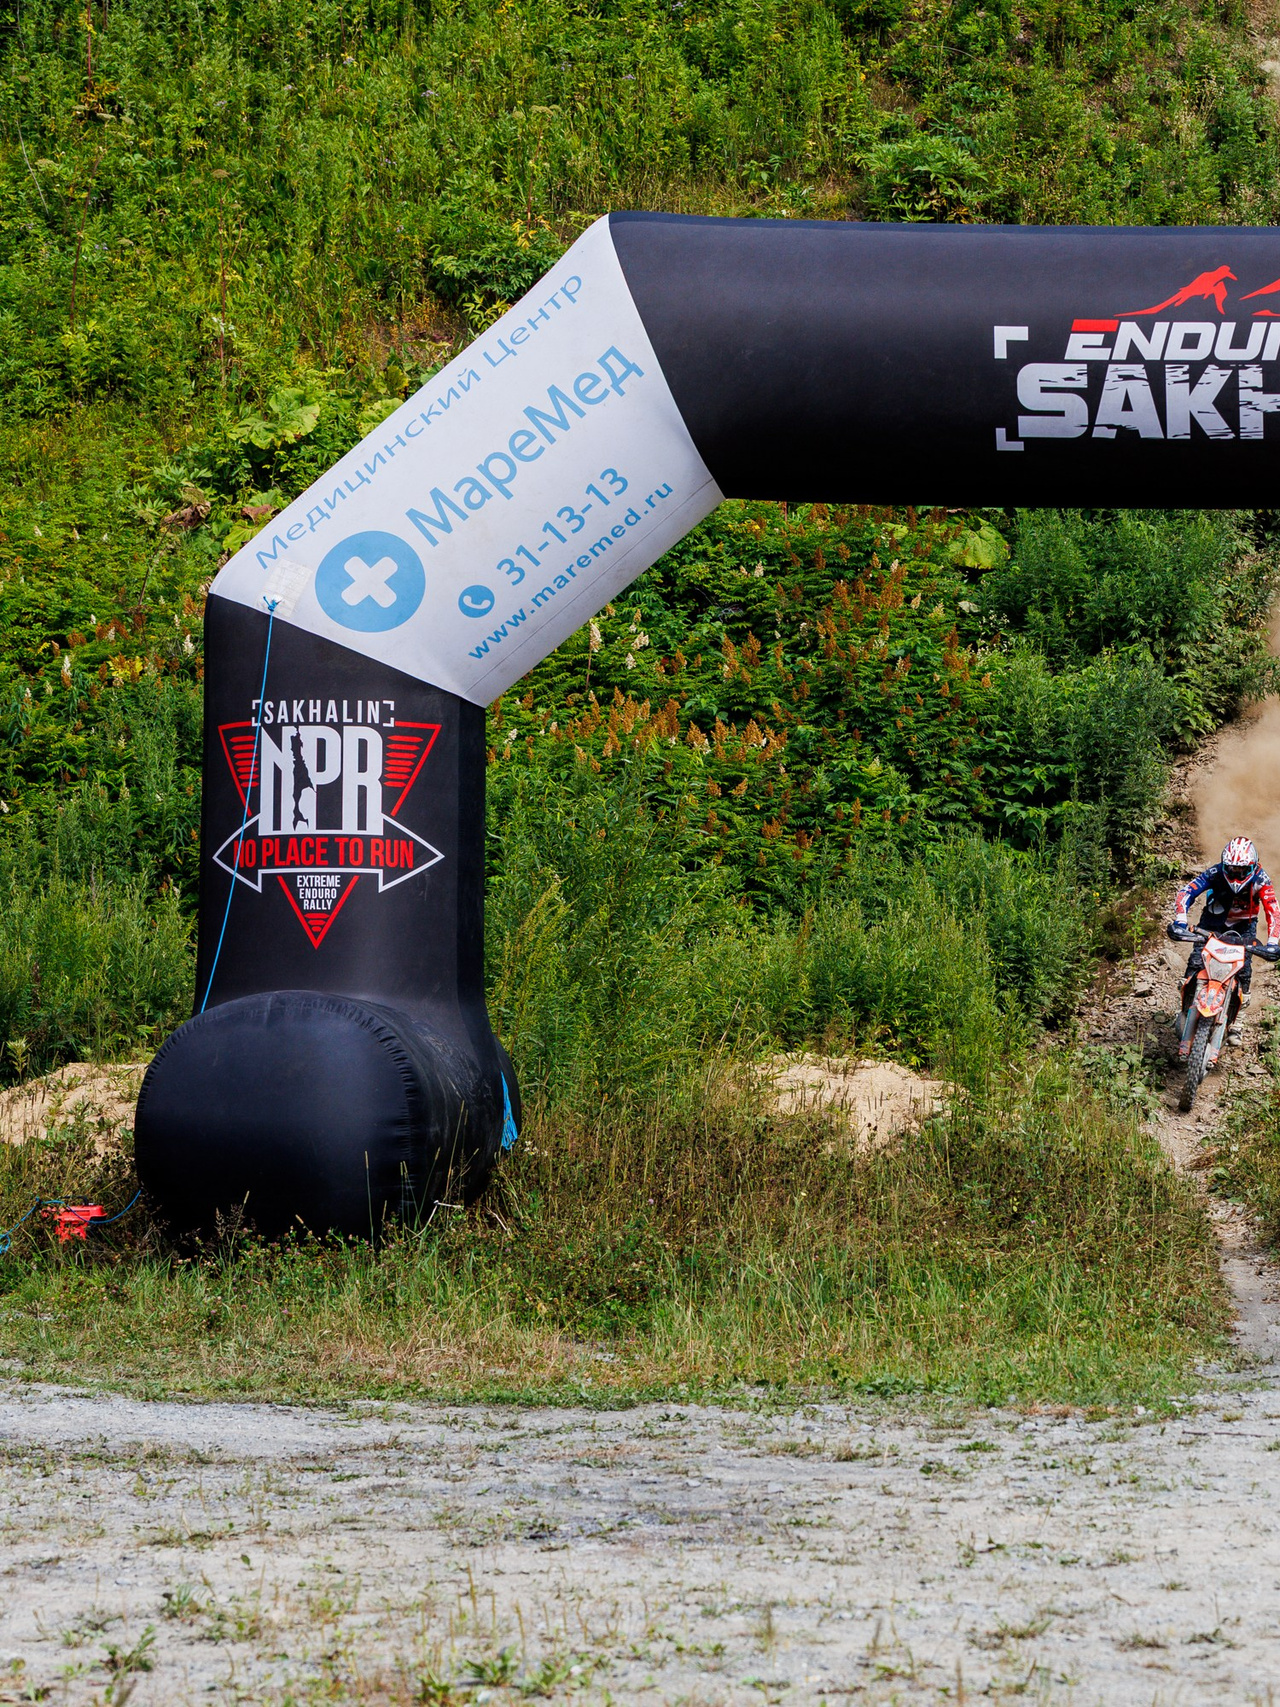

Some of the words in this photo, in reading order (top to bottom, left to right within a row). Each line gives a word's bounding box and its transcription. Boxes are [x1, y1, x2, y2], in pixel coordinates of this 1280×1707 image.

[255, 367, 482, 571] Медицинский
[483, 275, 583, 368] Центр
[405, 345, 645, 547] МареМед
[497, 468, 629, 586] 31-13-13
[468, 483, 674, 661] www.maremed.ru
[264, 700, 380, 724] SAKHALIN
[258, 725, 384, 835] NPR
[233, 839, 257, 868] NO
[262, 837, 329, 867] PLACE
[335, 837, 363, 866] TO
[370, 838, 414, 868] RUN
[297, 875, 341, 888] EXTREME
[299, 888, 337, 899] ENDURO
[303, 899, 333, 910] RALLY
